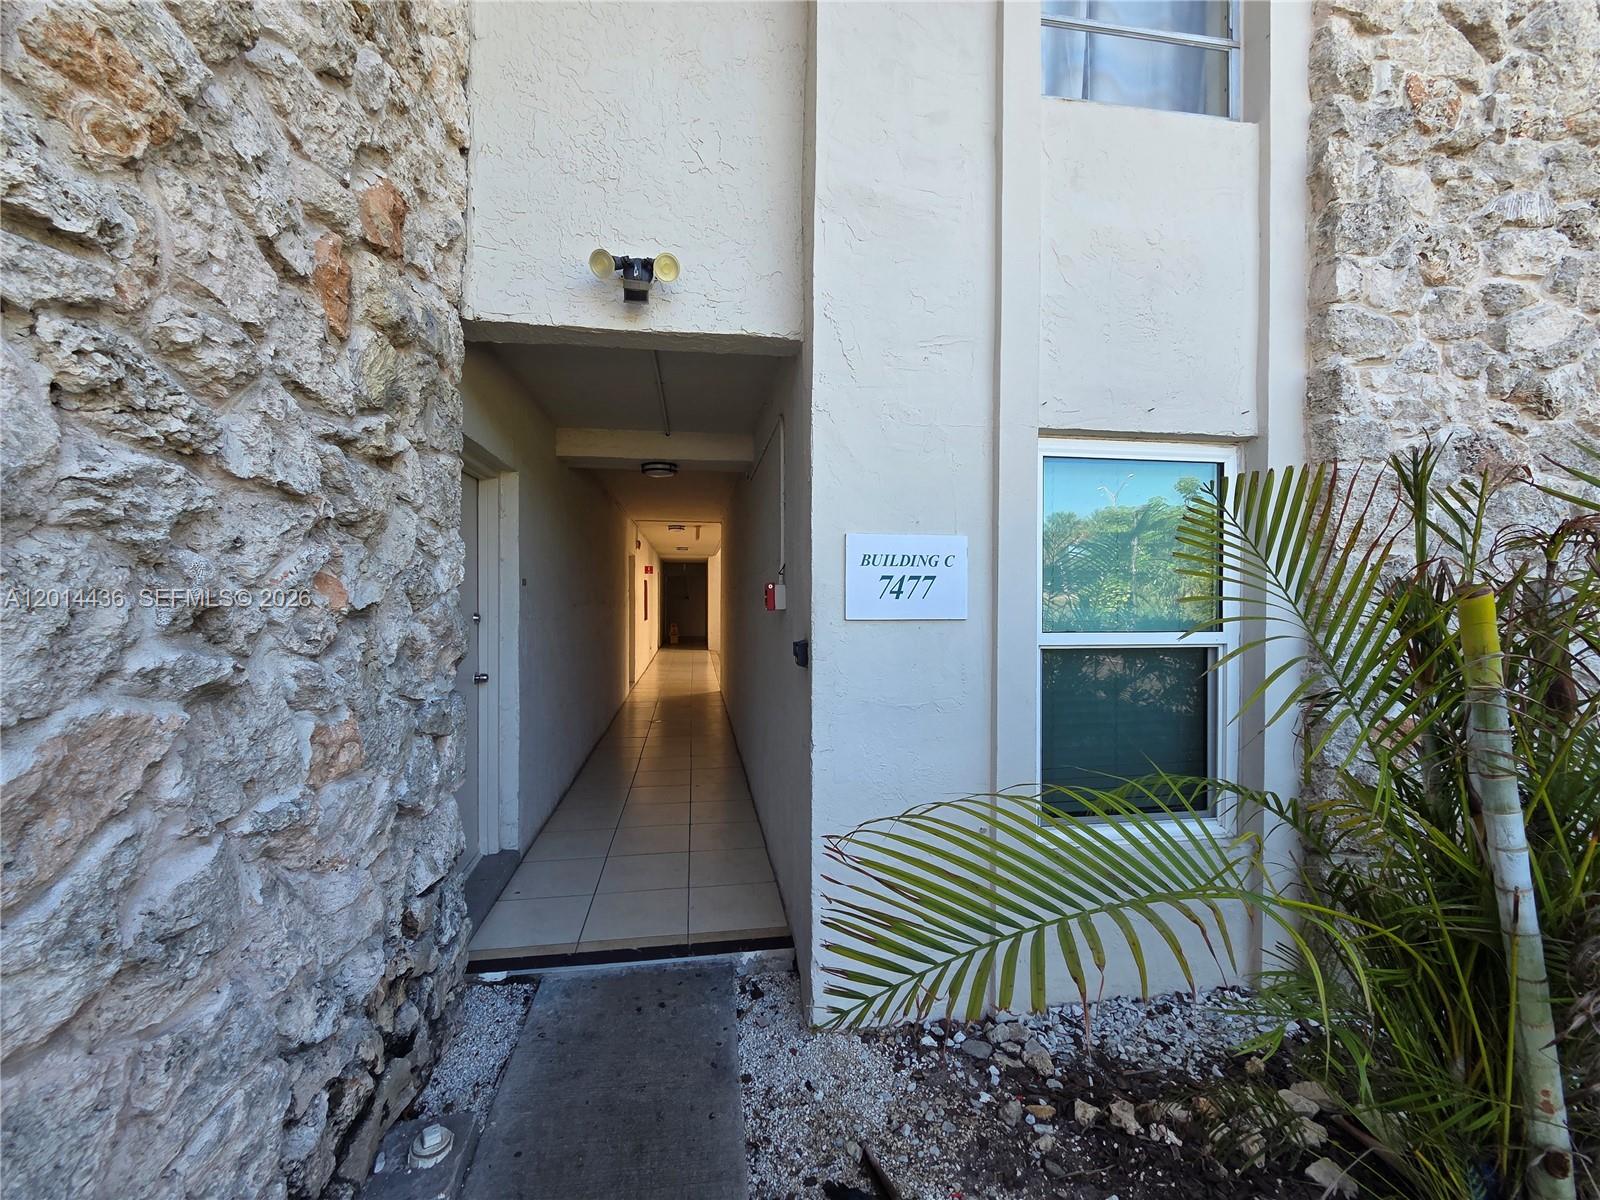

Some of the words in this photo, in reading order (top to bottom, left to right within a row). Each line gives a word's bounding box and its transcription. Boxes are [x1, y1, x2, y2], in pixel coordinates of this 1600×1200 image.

[860, 553, 940, 567] BUILDING
[944, 554, 956, 568] C
[878, 574, 937, 600] 7477
